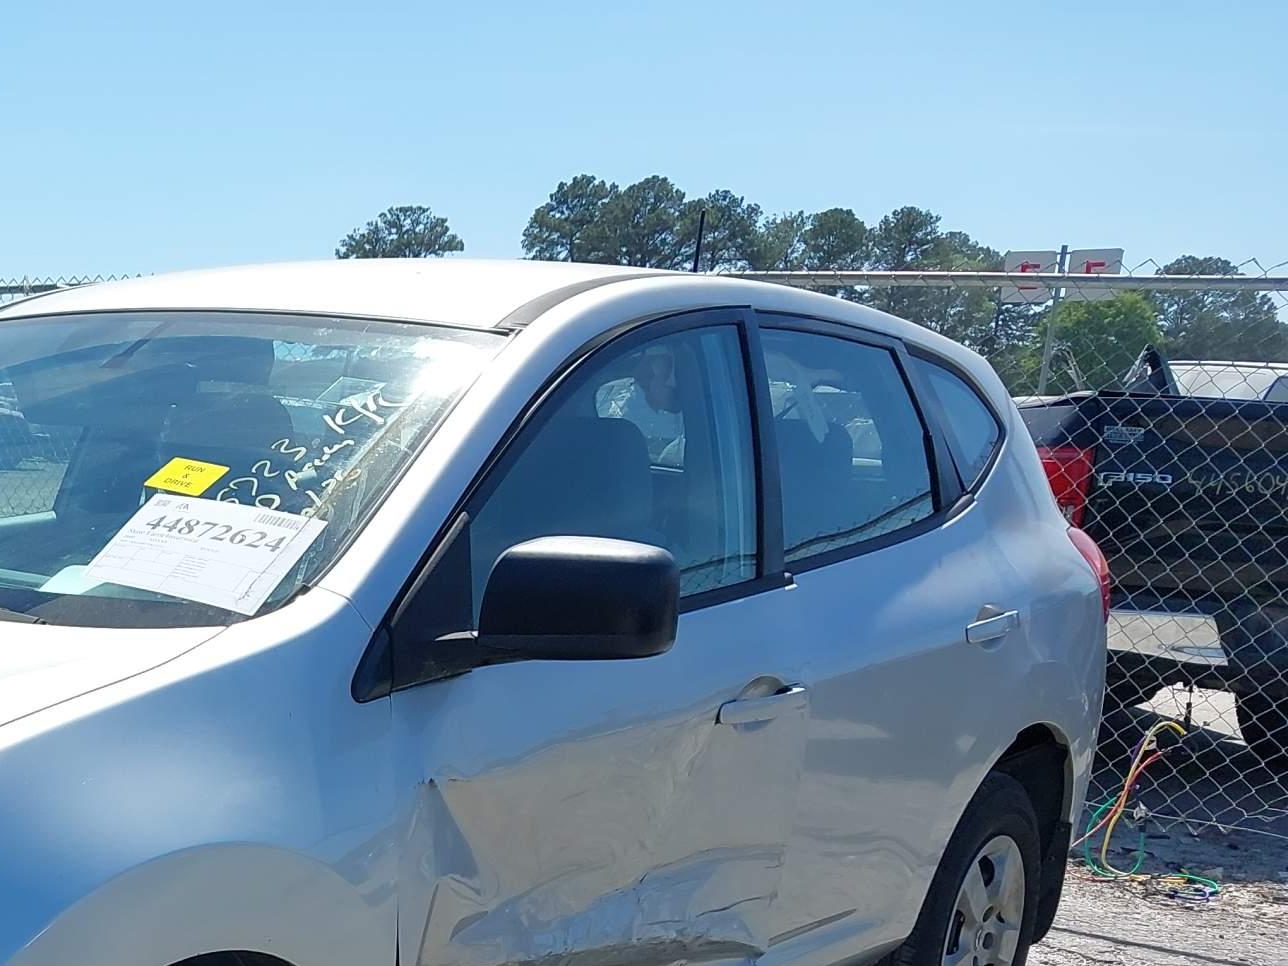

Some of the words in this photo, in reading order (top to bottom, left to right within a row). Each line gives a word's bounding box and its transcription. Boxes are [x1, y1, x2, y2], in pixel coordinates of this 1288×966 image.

[184, 464, 206, 472] RUN
[164, 477, 193, 488] DRIVE
[145, 515, 287, 552] 44872624
